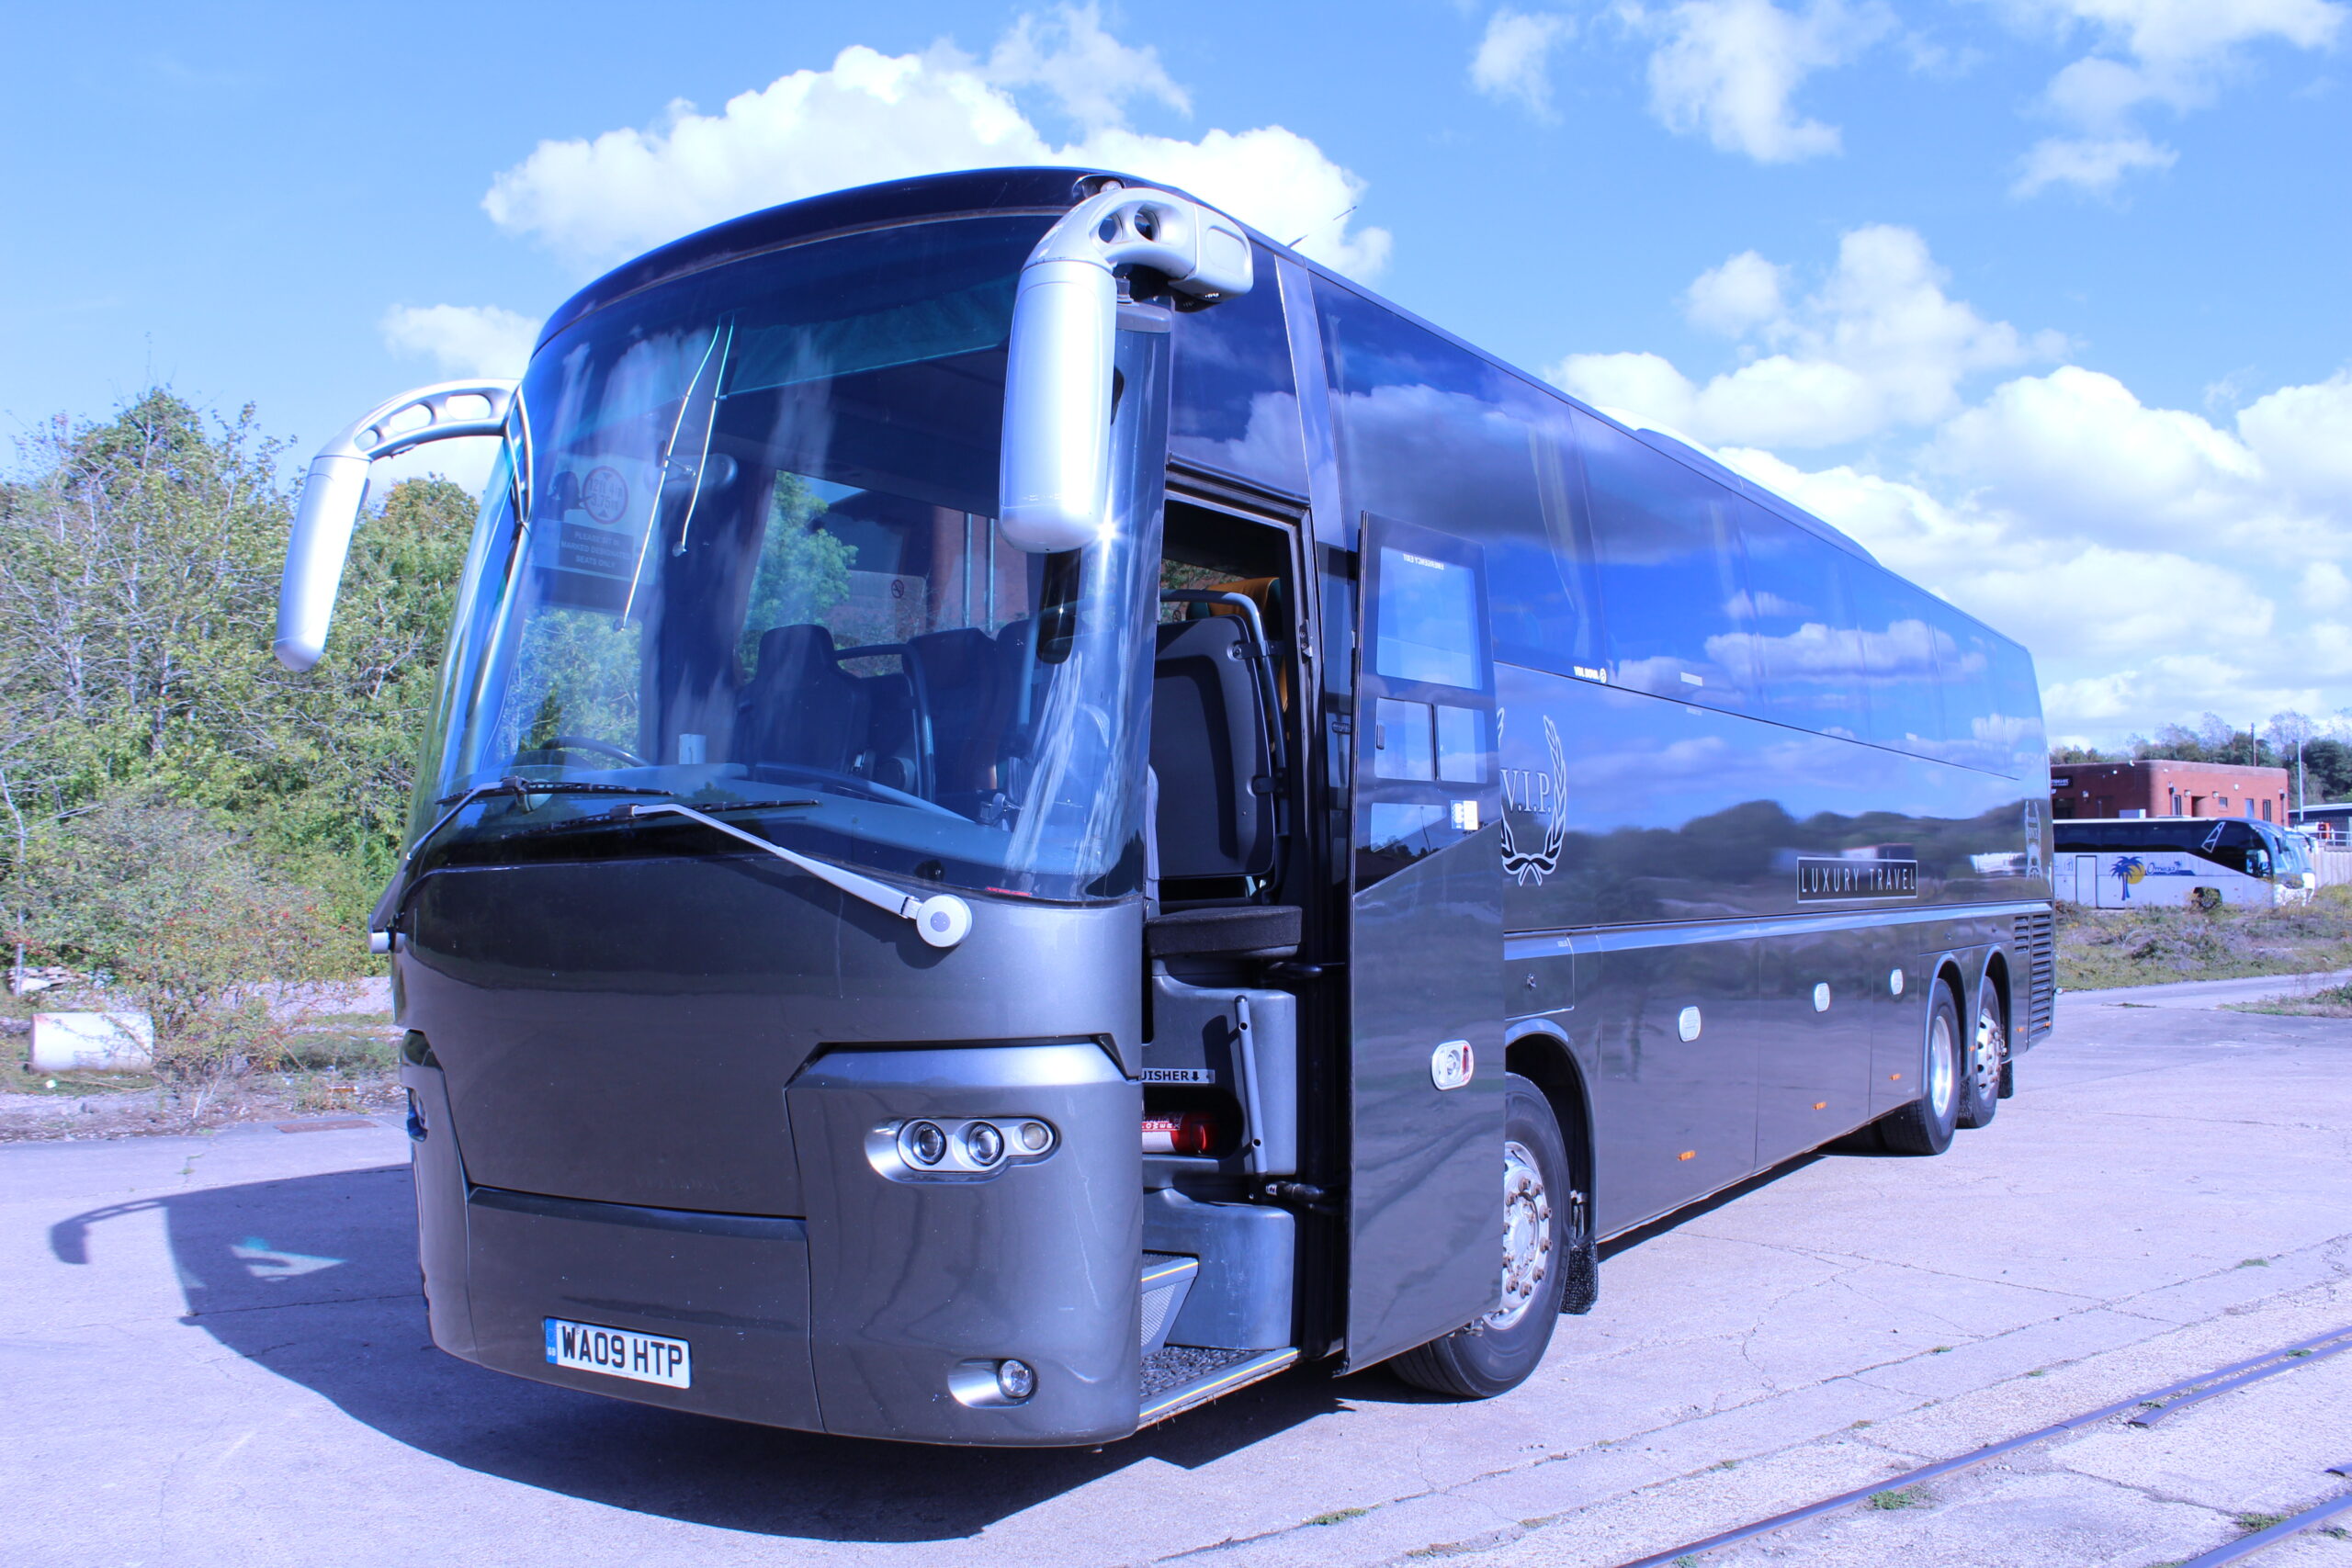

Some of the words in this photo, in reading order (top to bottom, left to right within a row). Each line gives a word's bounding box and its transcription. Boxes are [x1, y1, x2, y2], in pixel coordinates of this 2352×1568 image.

[1499, 768, 1551, 813] V.I.P.
[1801, 867, 1859, 893] LUXURY
[1869, 868, 1915, 891] TRAVEL
[562, 1325, 626, 1369] WA09
[634, 1338, 684, 1378] HTP
